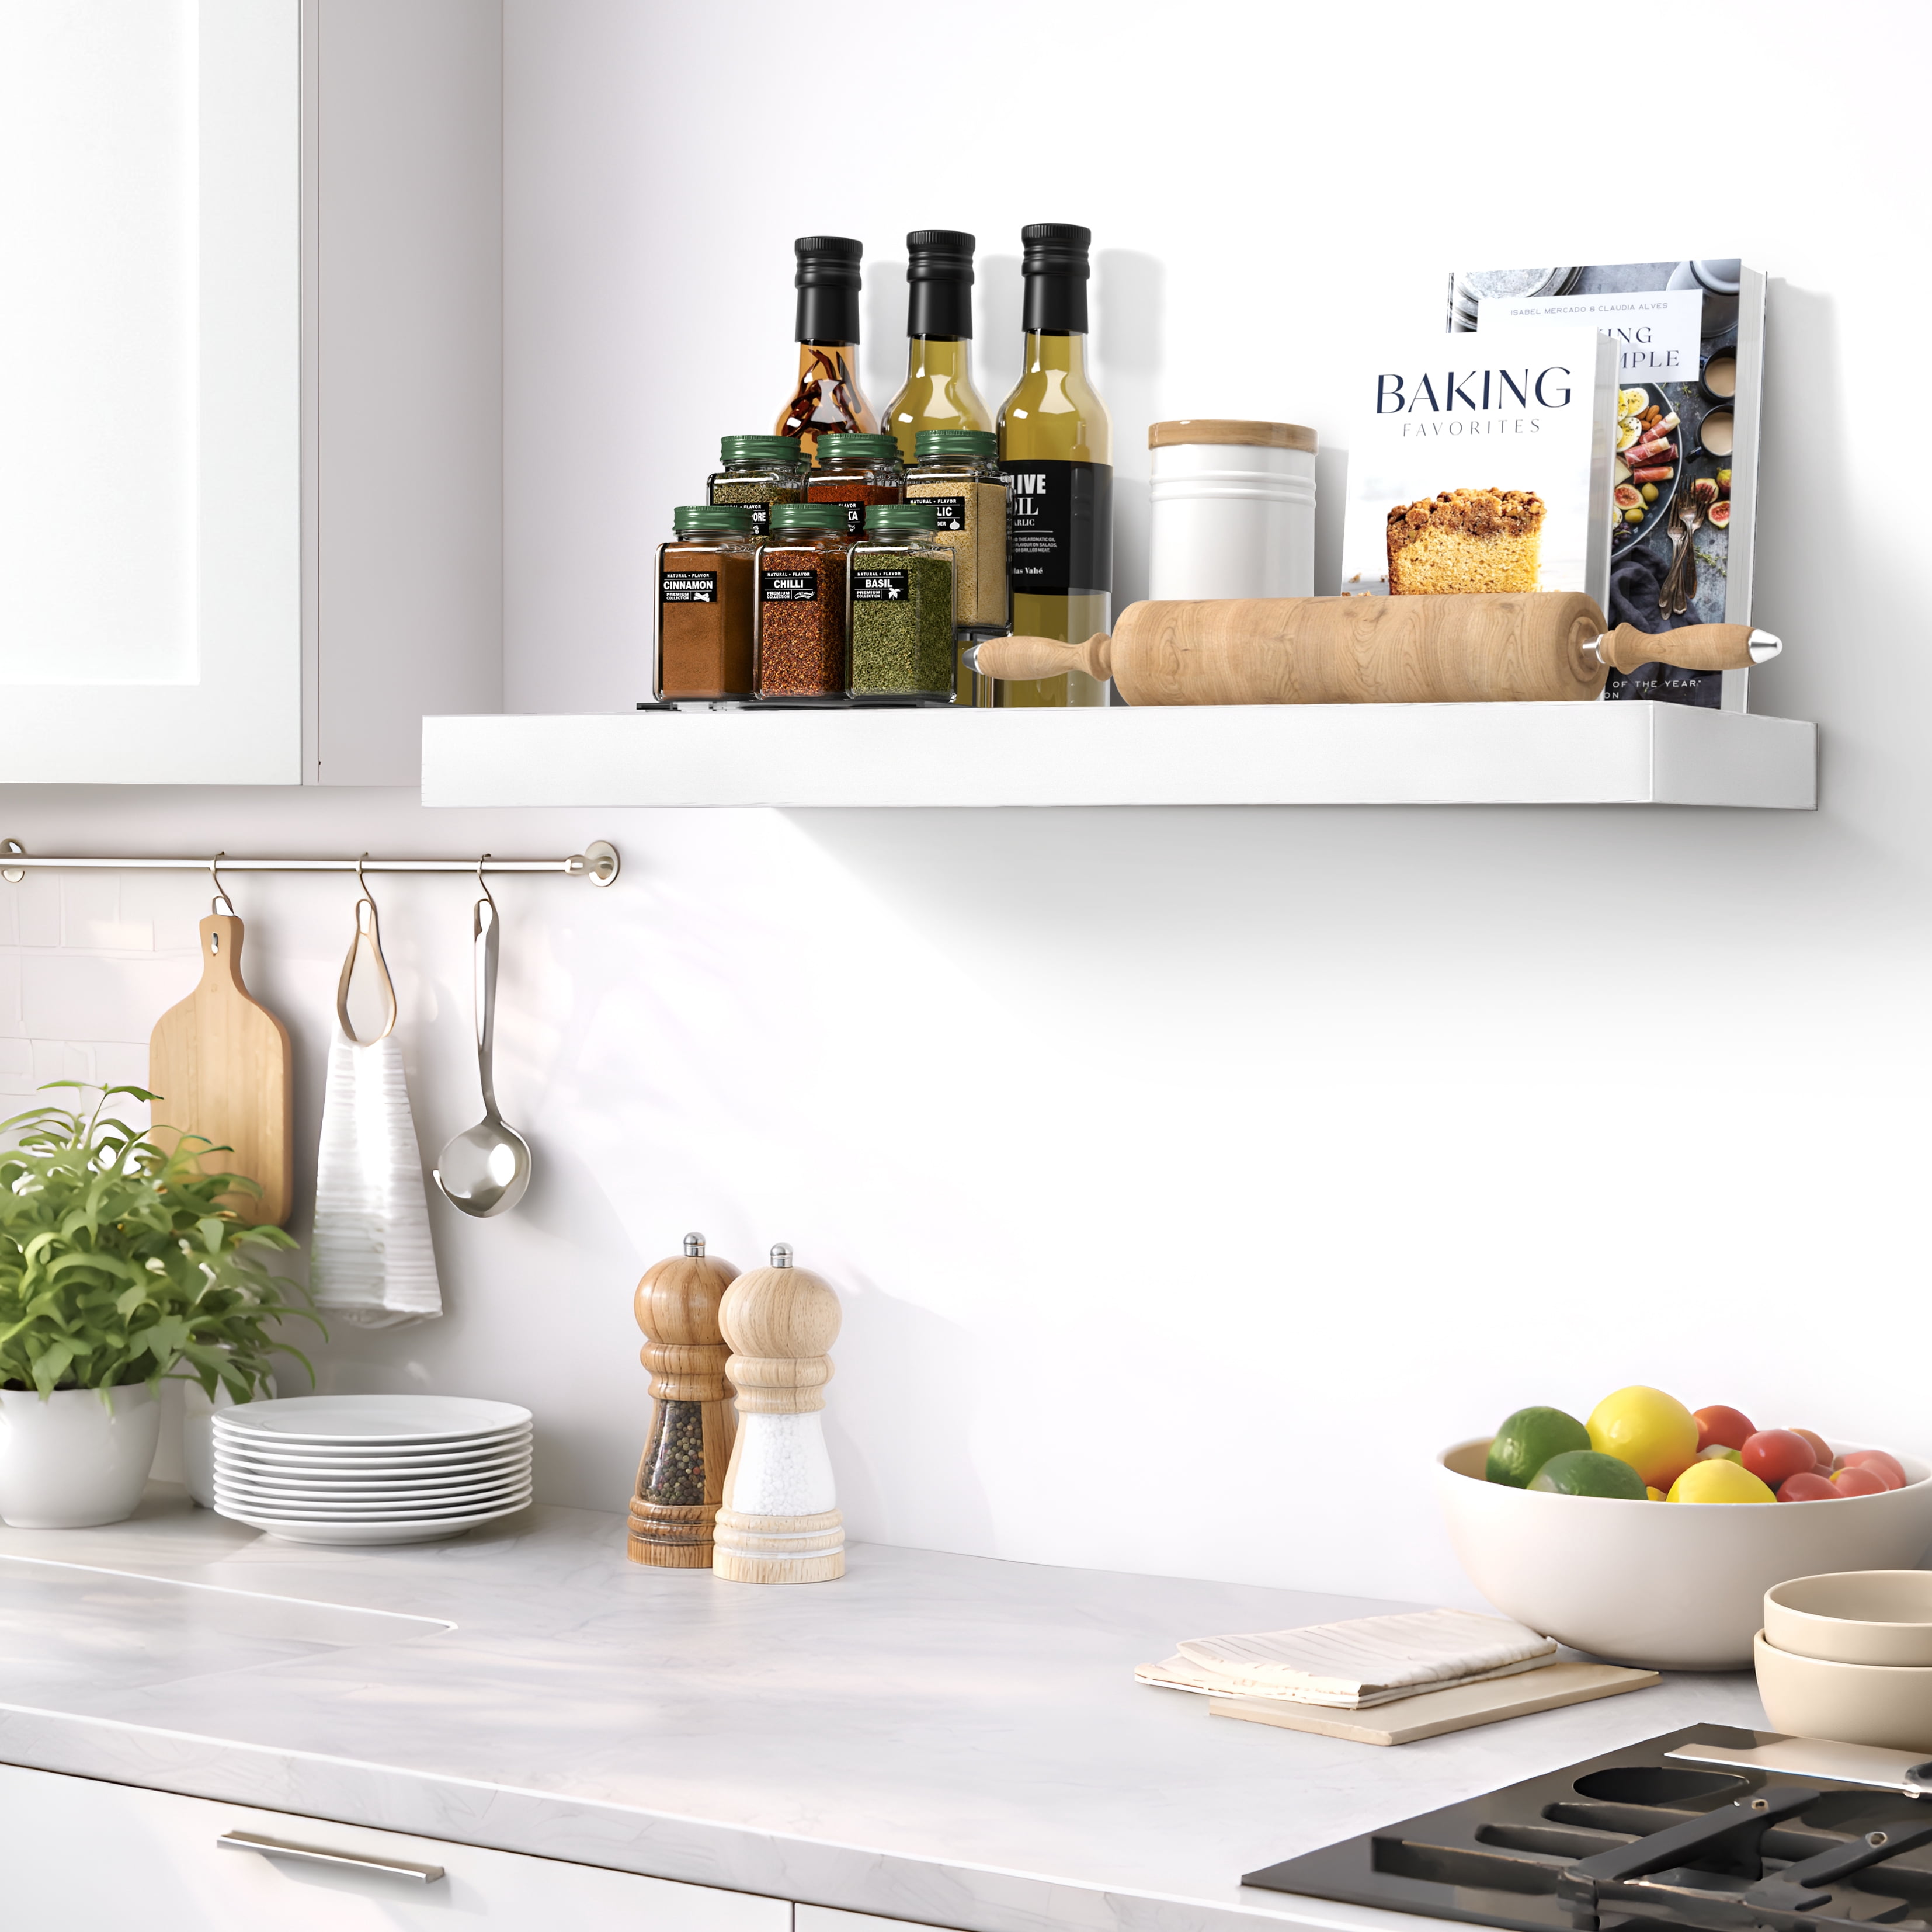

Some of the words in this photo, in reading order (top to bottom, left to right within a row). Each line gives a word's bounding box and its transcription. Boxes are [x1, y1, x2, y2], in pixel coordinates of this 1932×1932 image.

[1544, 306, 1587, 314] MERCADO
[1598, 304, 1635, 312] CLAUDIA
[1599, 326, 1652, 343] ING
[1376, 366, 1571, 414] BAKING
[1403, 418, 1540, 437] FAVORITES
[1014, 496, 1039, 515] IL
[663, 581, 713, 590] CINNAMON
[773, 579, 804, 589] CHILLI
[865, 579, 893, 588] BASIL
